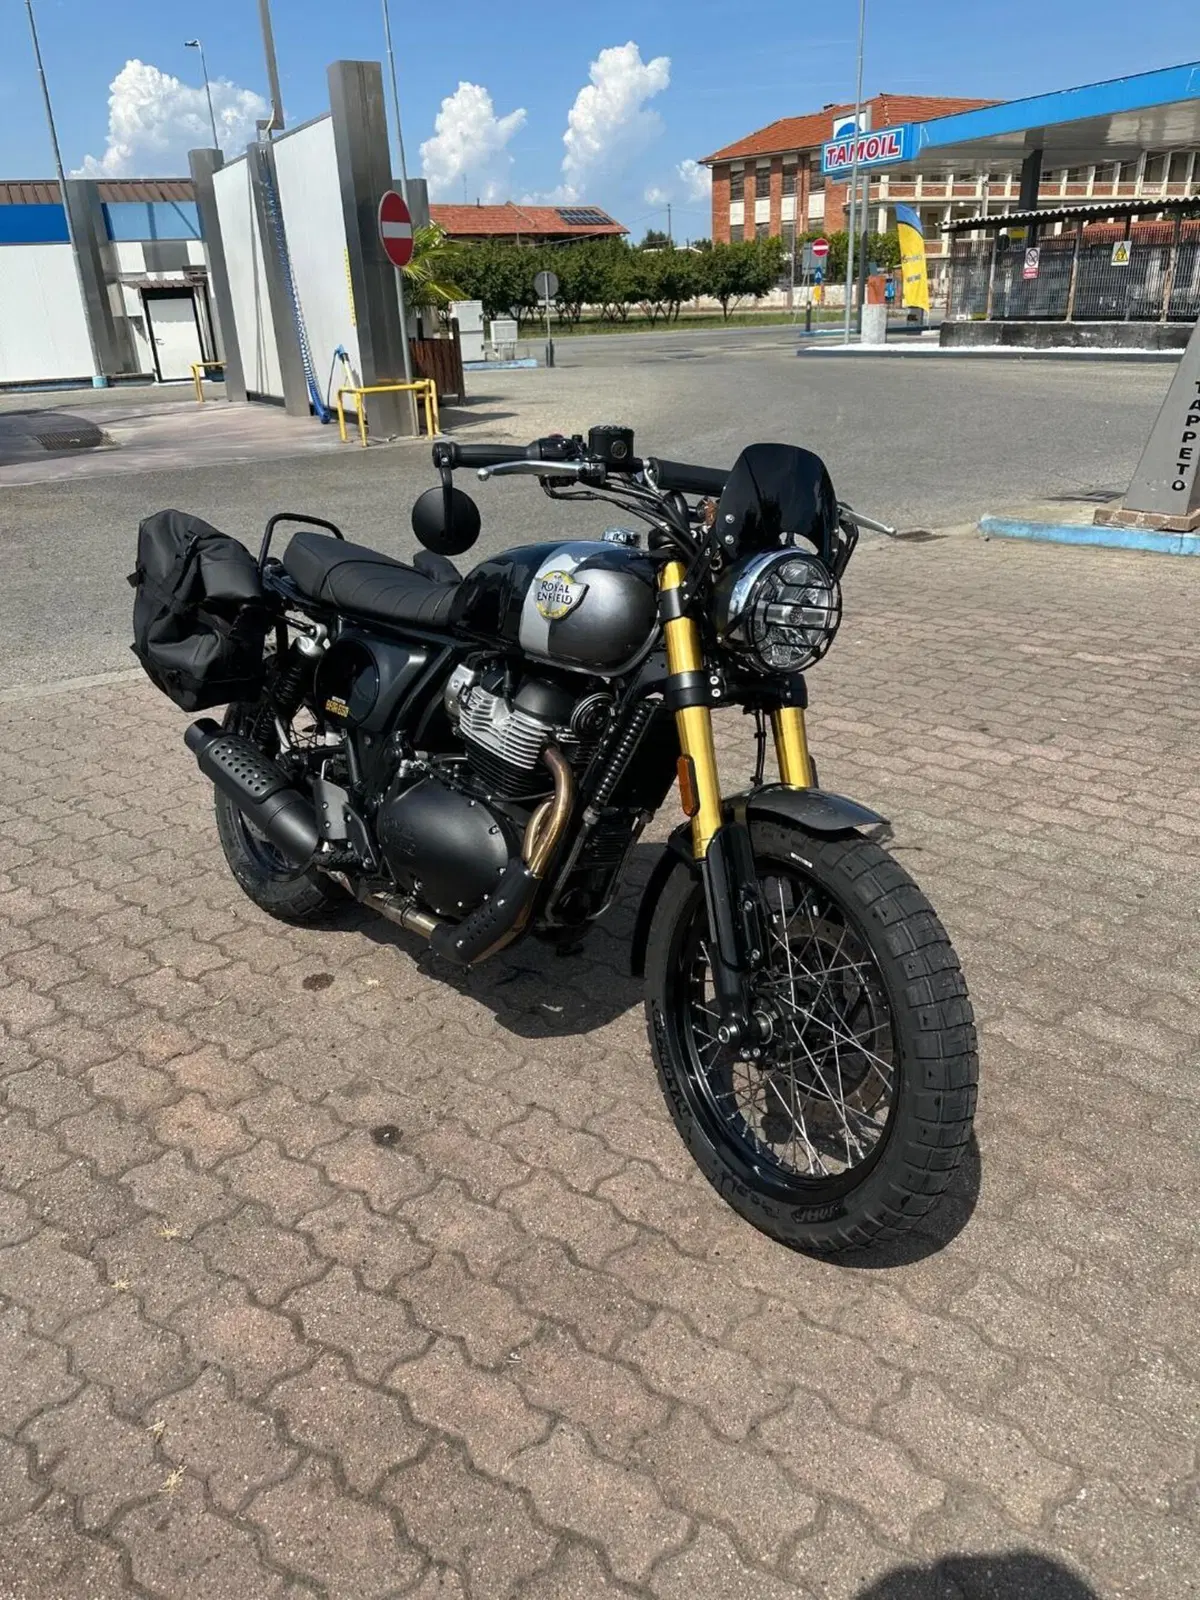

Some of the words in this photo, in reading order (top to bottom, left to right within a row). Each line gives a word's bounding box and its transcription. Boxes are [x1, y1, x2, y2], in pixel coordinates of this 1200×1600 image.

[826, 134, 901, 168] TAMOIL
[541, 580, 570, 593] ROYAL
[537, 592, 573, 605] ENFIELD
